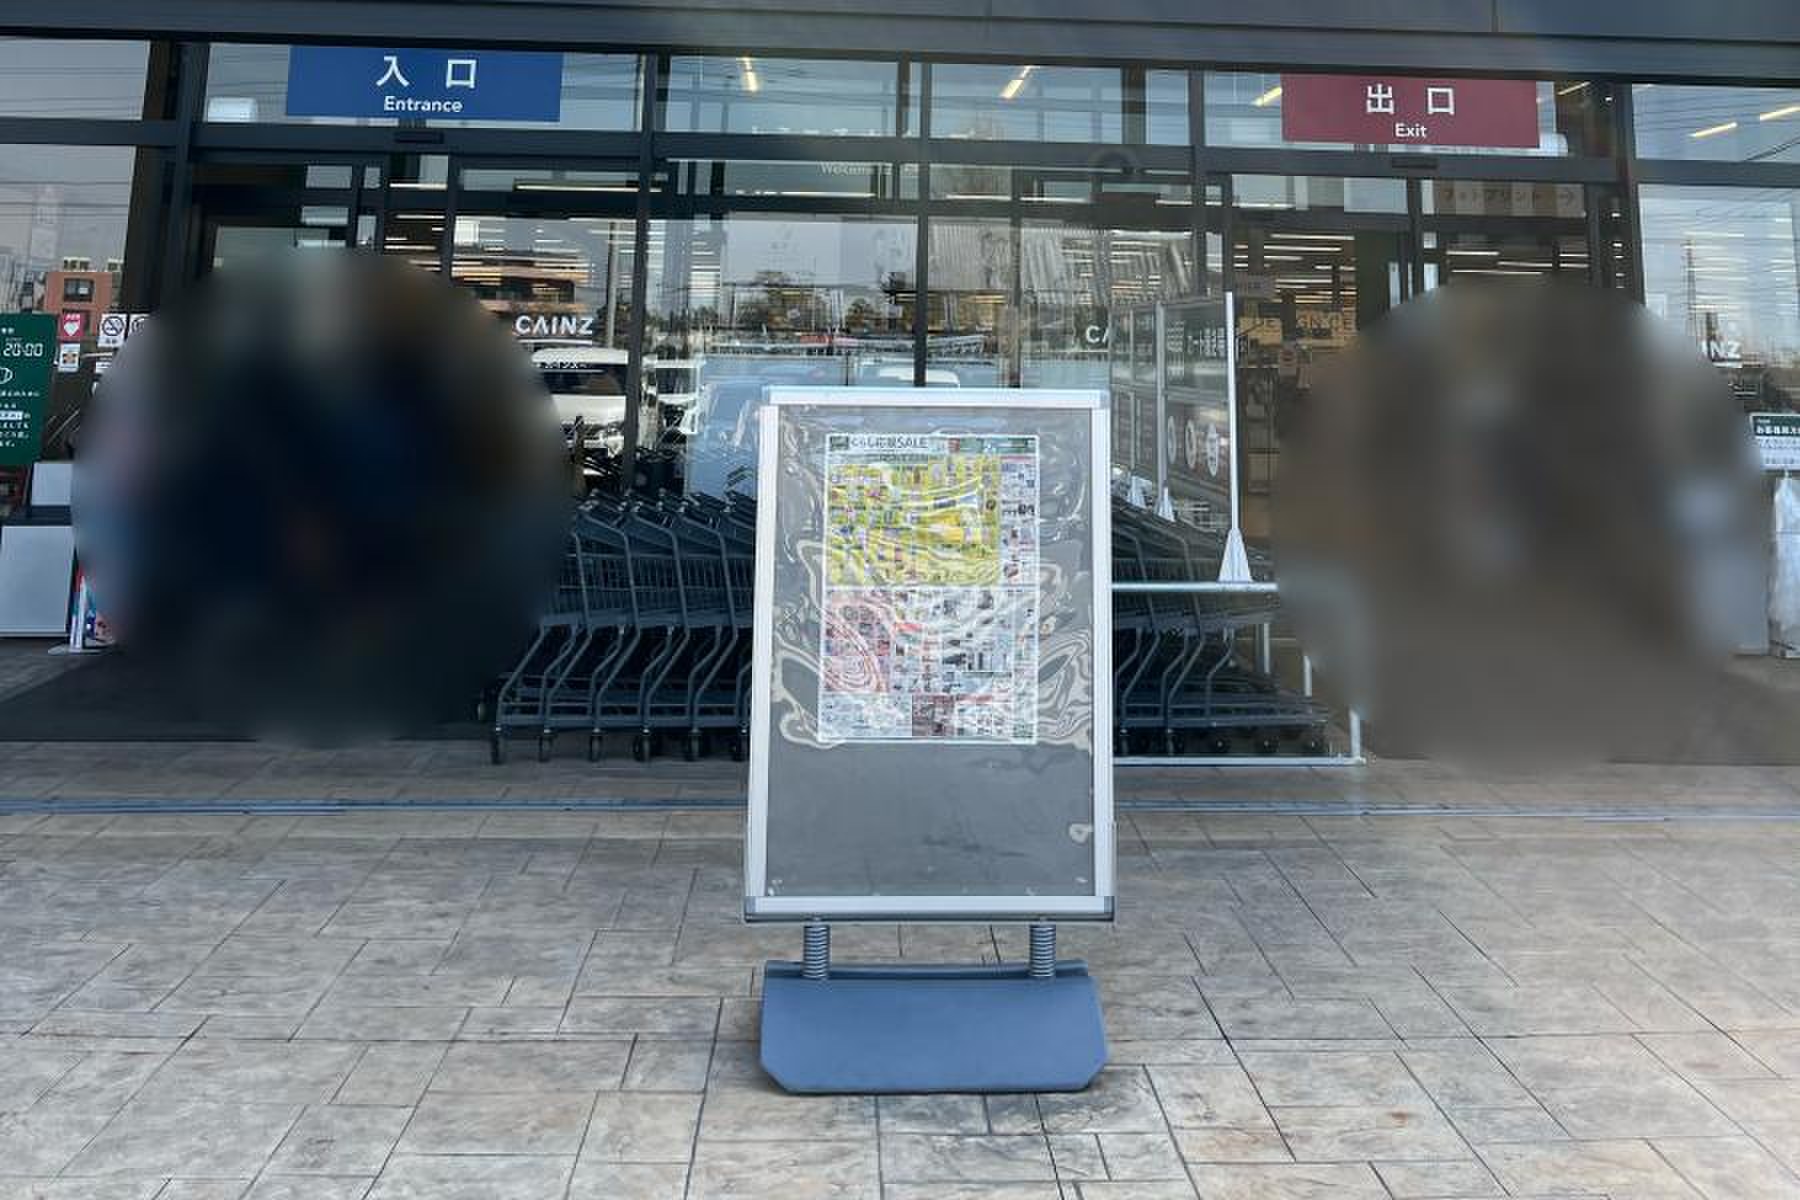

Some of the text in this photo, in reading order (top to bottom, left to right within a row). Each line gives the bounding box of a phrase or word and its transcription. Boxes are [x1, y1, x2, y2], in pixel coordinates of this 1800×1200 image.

[376, 56, 476, 88] 入口
[383, 96, 463, 112] Entrance
[1366, 84, 1454, 114] 出口
[1395, 123, 1427, 138] Exit
[515, 315, 594, 335] CAINZ
